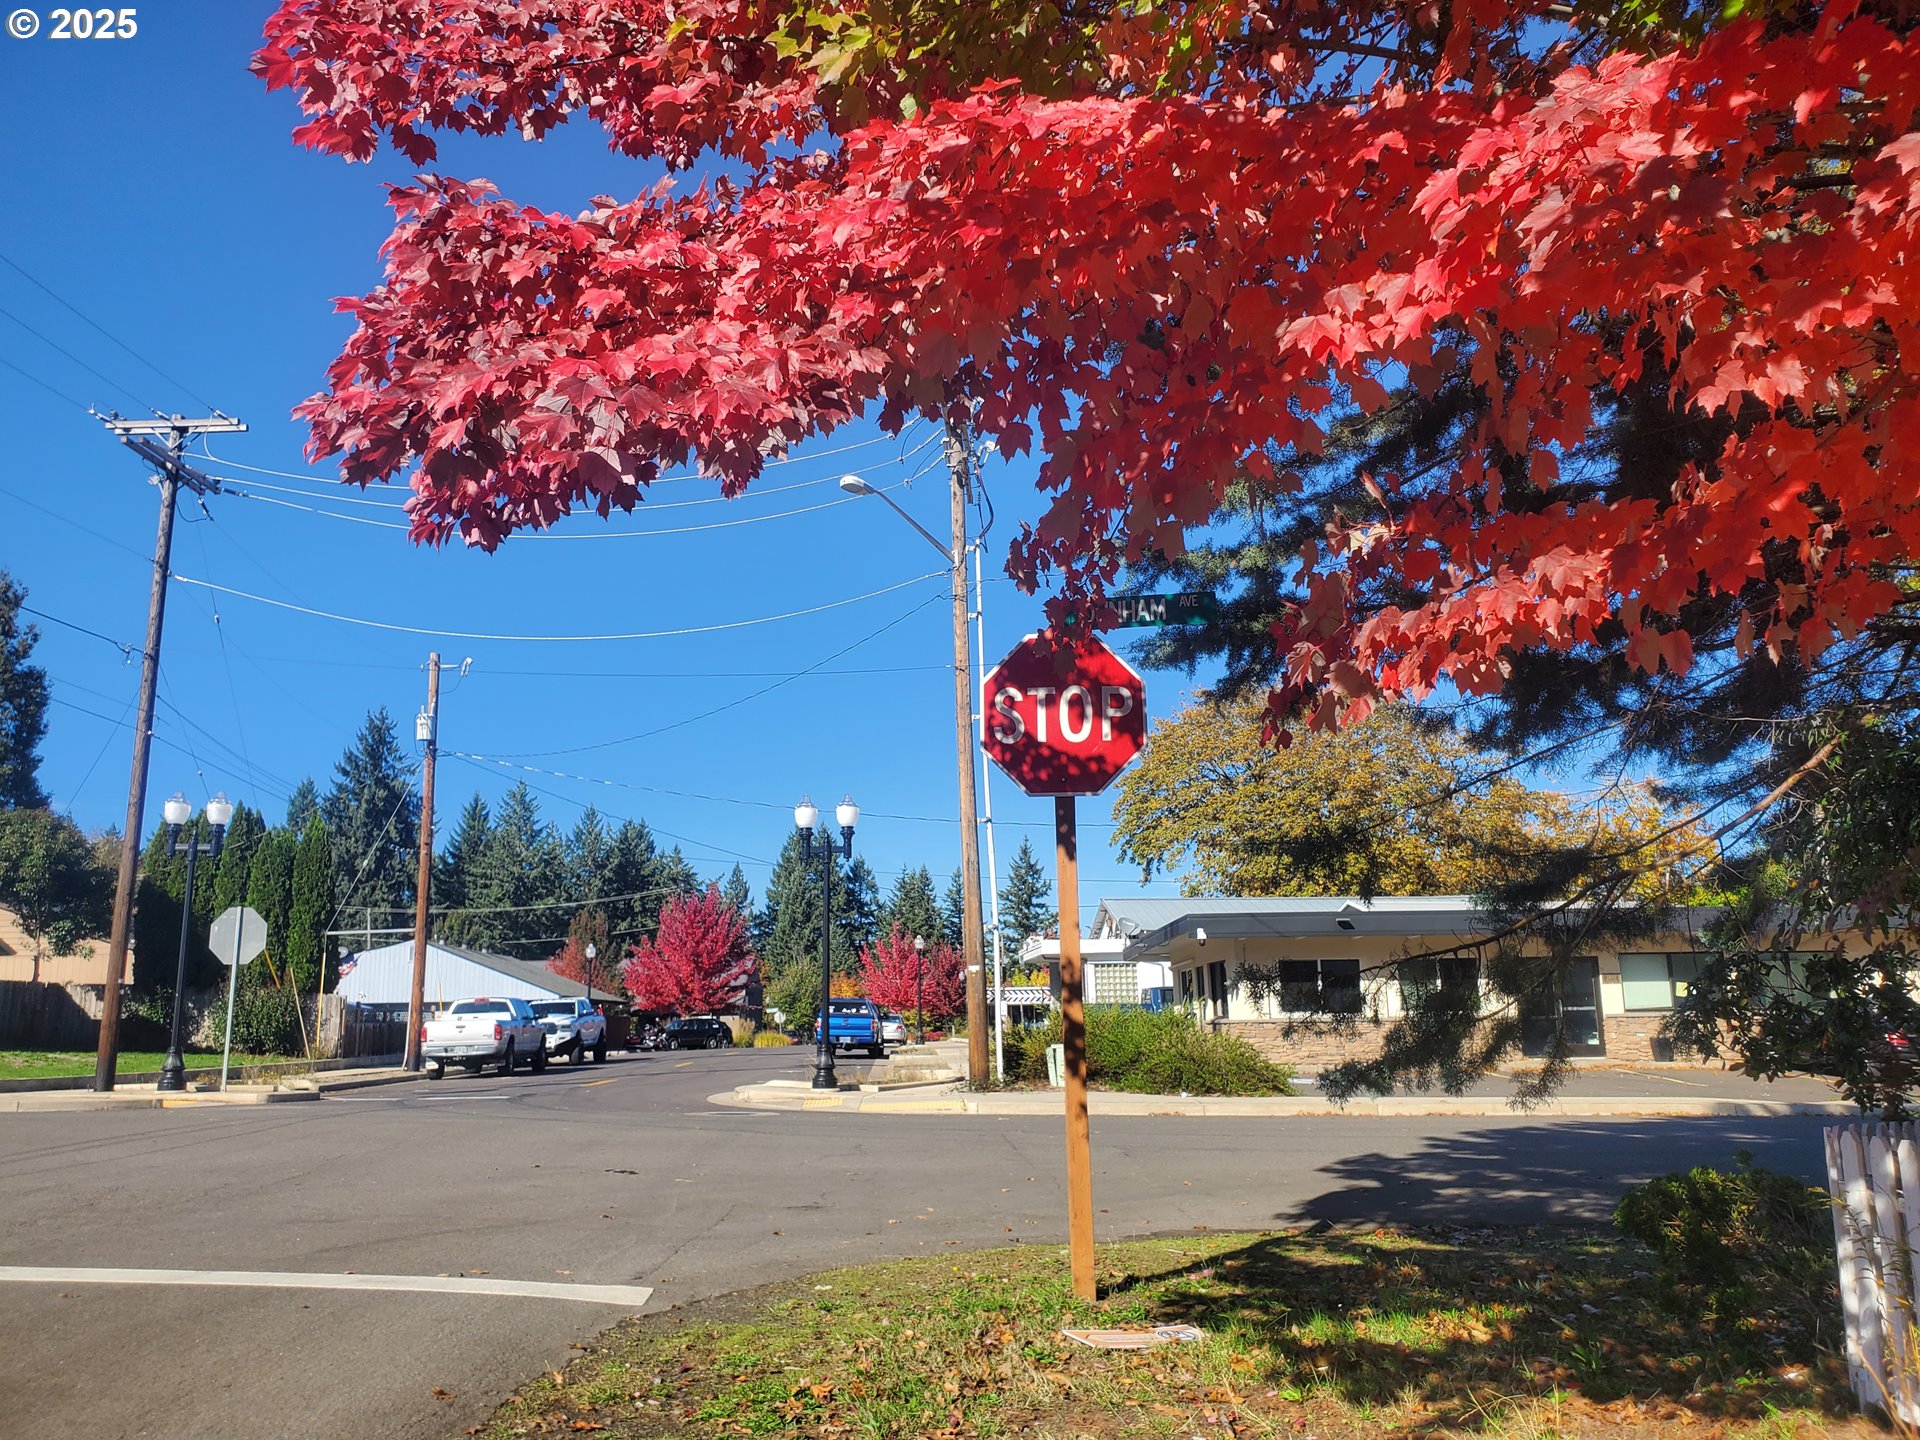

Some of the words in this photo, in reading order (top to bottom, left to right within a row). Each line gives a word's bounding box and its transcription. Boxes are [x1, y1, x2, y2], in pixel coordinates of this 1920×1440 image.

[1087, 598, 1167, 623] NHAM
[1179, 594, 1199, 608] AVE
[993, 684, 1133, 745] STOP
